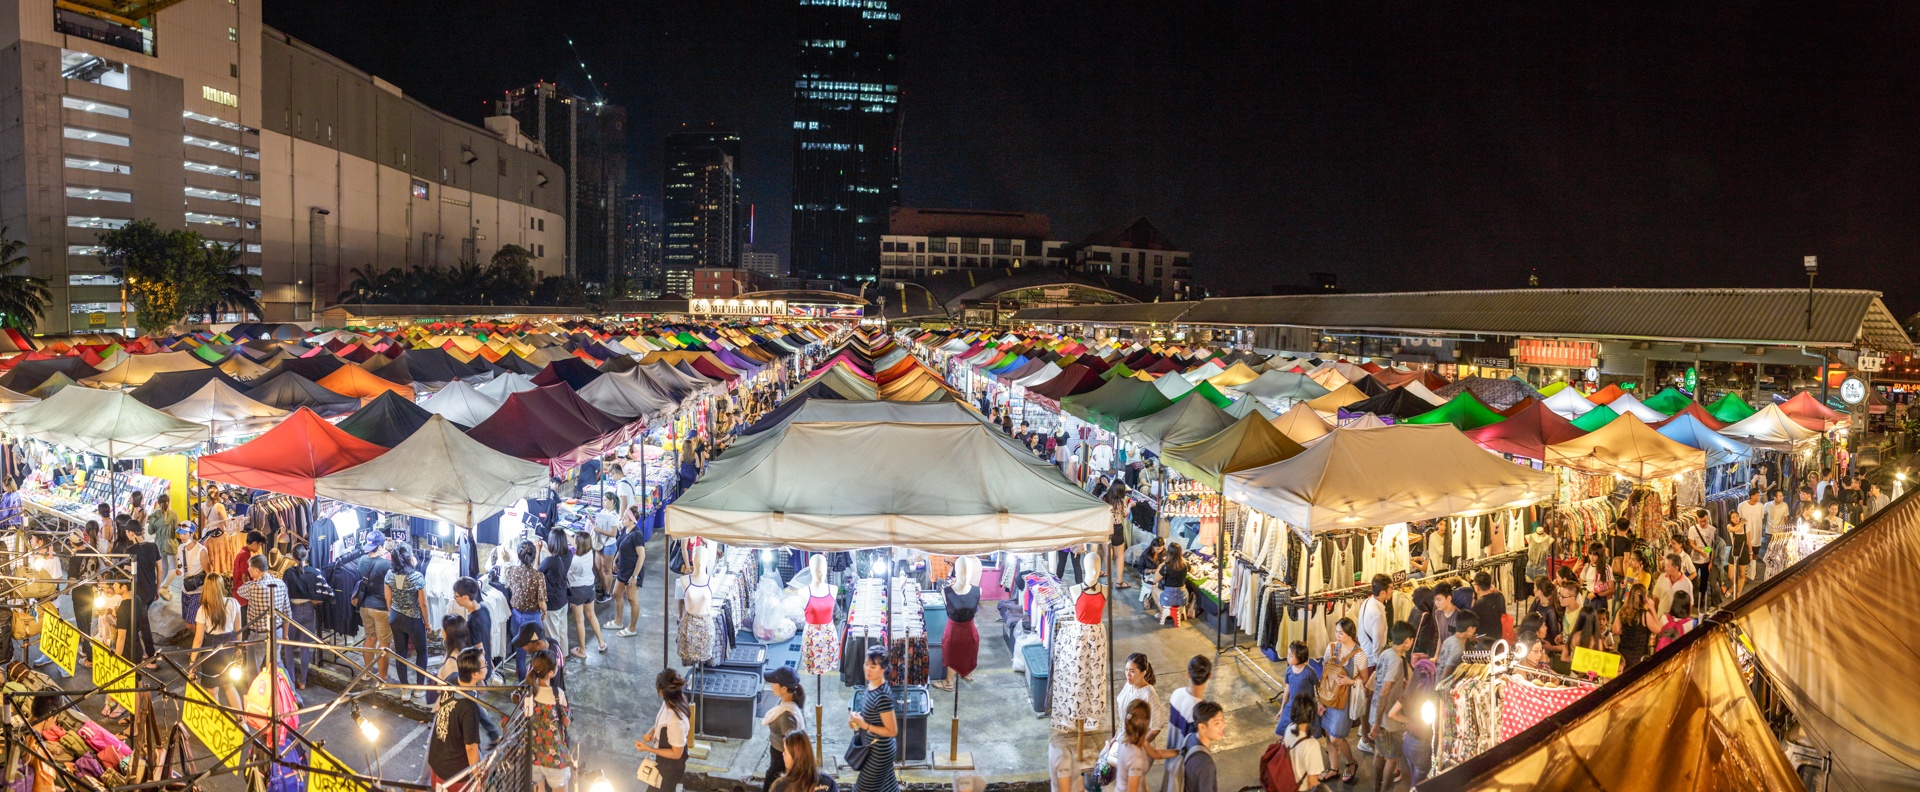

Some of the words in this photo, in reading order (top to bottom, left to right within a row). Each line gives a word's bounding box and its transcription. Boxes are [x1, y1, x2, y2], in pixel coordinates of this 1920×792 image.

[1512, 457, 1531, 466] OPEN
[392, 531, 406, 541] 150
[431, 535, 438, 546] M
[1462, 560, 1473, 569] 150
[1393, 572, 1406, 582] 150
